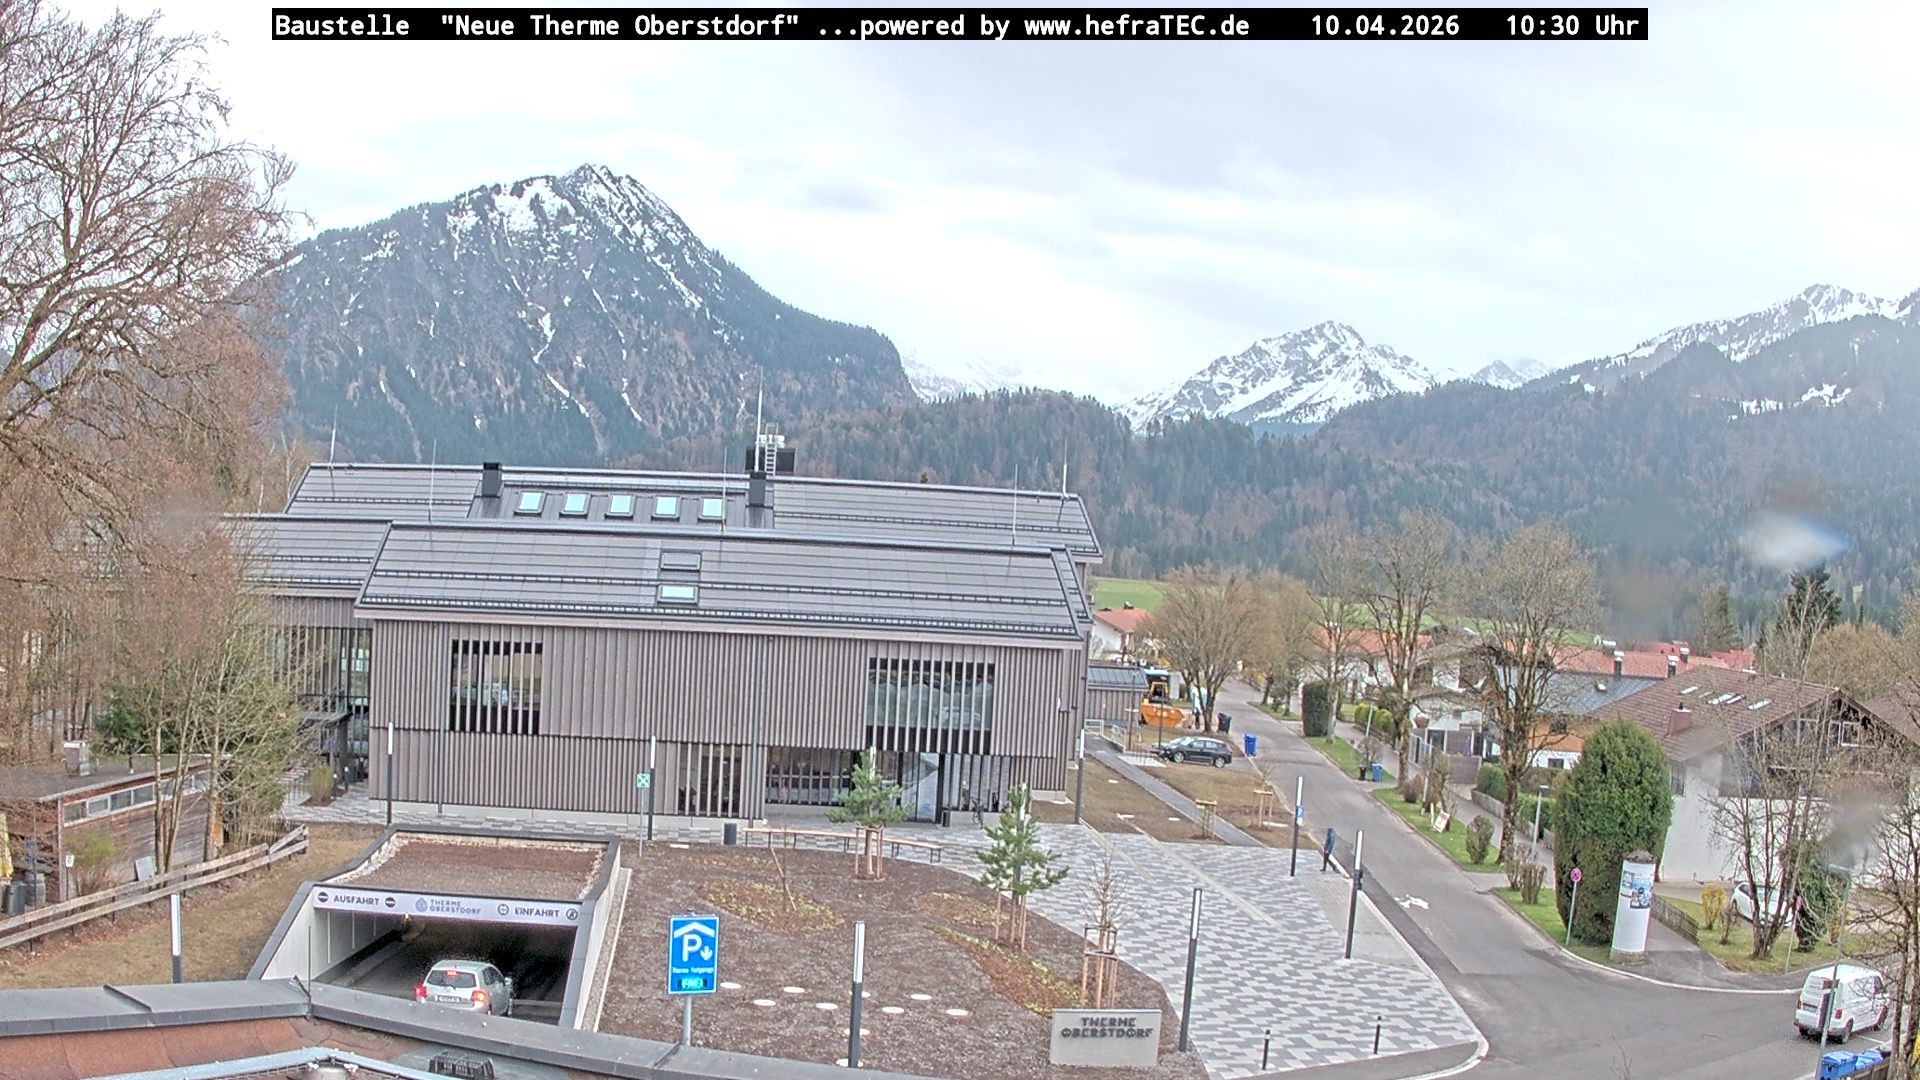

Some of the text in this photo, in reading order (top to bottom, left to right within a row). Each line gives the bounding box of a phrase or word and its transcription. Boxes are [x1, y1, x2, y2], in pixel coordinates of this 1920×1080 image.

[333, 894, 380, 906] AUSFAHRT
[430, 899, 461, 907] THERME
[429, 905, 481, 915] OBERSTDORF
[514, 907, 560, 918] EINFAHRT
[682, 934, 703, 962] P
[1081, 1017, 1136, 1026] THERME
[1061, 1028, 1153, 1037] OBERSTDORF
